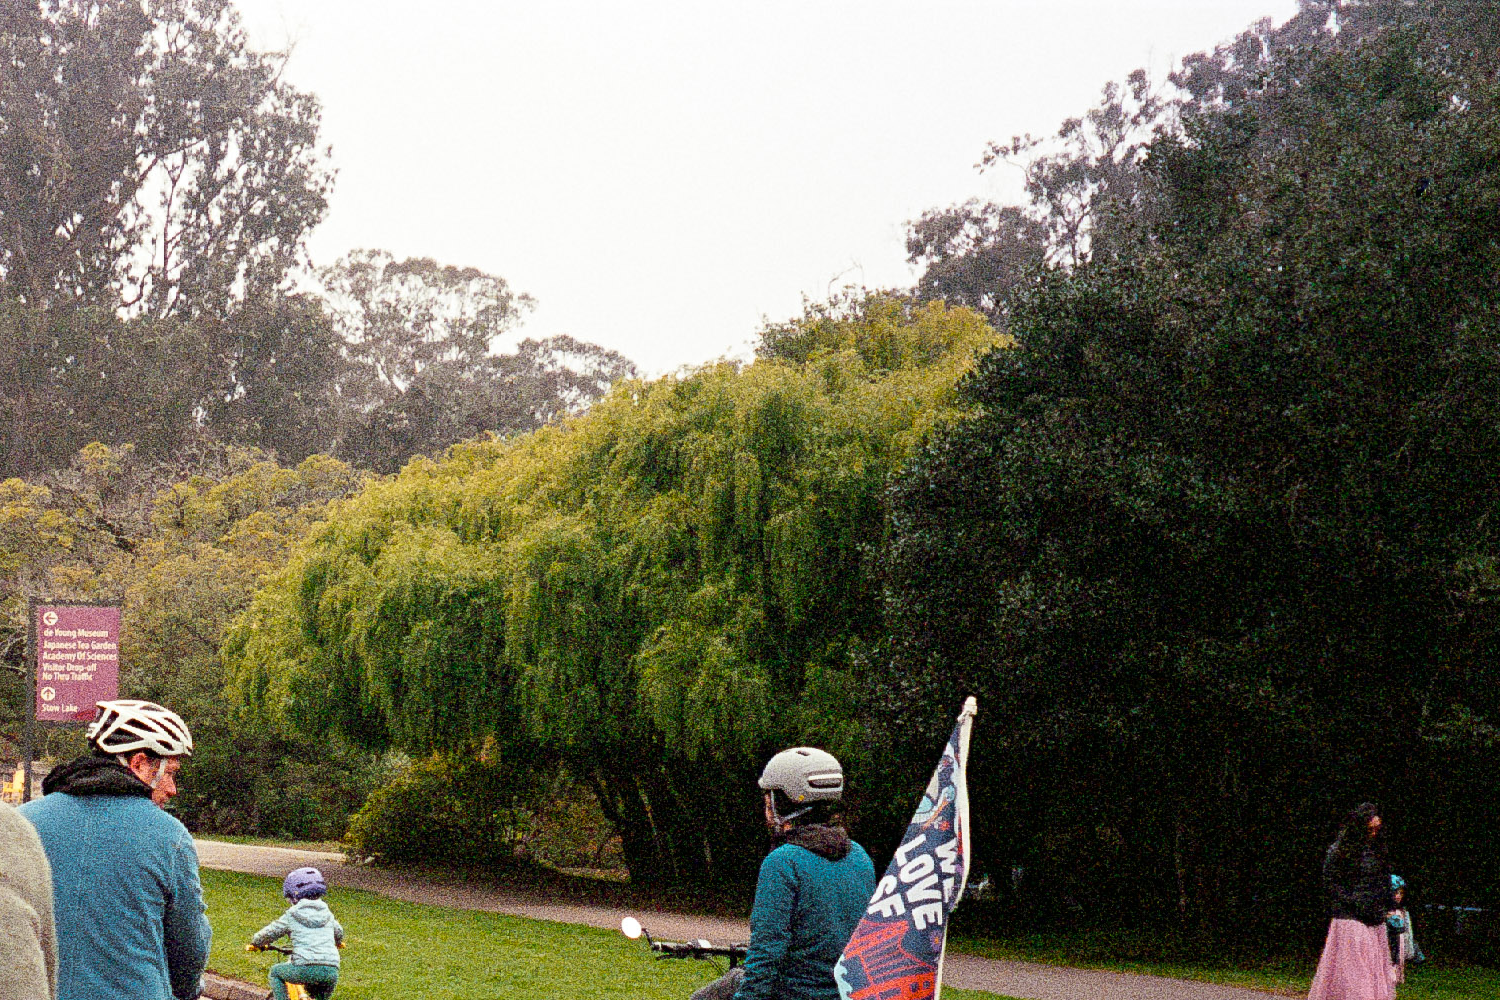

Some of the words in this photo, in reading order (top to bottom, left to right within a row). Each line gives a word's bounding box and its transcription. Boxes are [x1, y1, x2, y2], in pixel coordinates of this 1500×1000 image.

[43, 628, 53, 637] de
[55, 628, 77, 639] Young
[78, 628, 109, 637] Museum
[43, 641, 77, 651] Japanese
[78, 641, 90, 650] Tea
[91, 641, 117, 650] Garden
[42, 652, 76, 662] Academy
[77, 652, 86, 660] Of
[87, 652, 117, 660] Sciences
[43, 663, 66, 671] Visitor
[67, 663, 97, 672] Drop-off
[42, 672, 53, 680] No
[54, 672, 70, 680] Thru
[71, 672, 93, 680] Traffic
[42, 704, 60, 712] Stow
[61, 704, 78, 712] Lake
[895, 833, 943, 930] LOVE
[867, 875, 906, 917] SF
